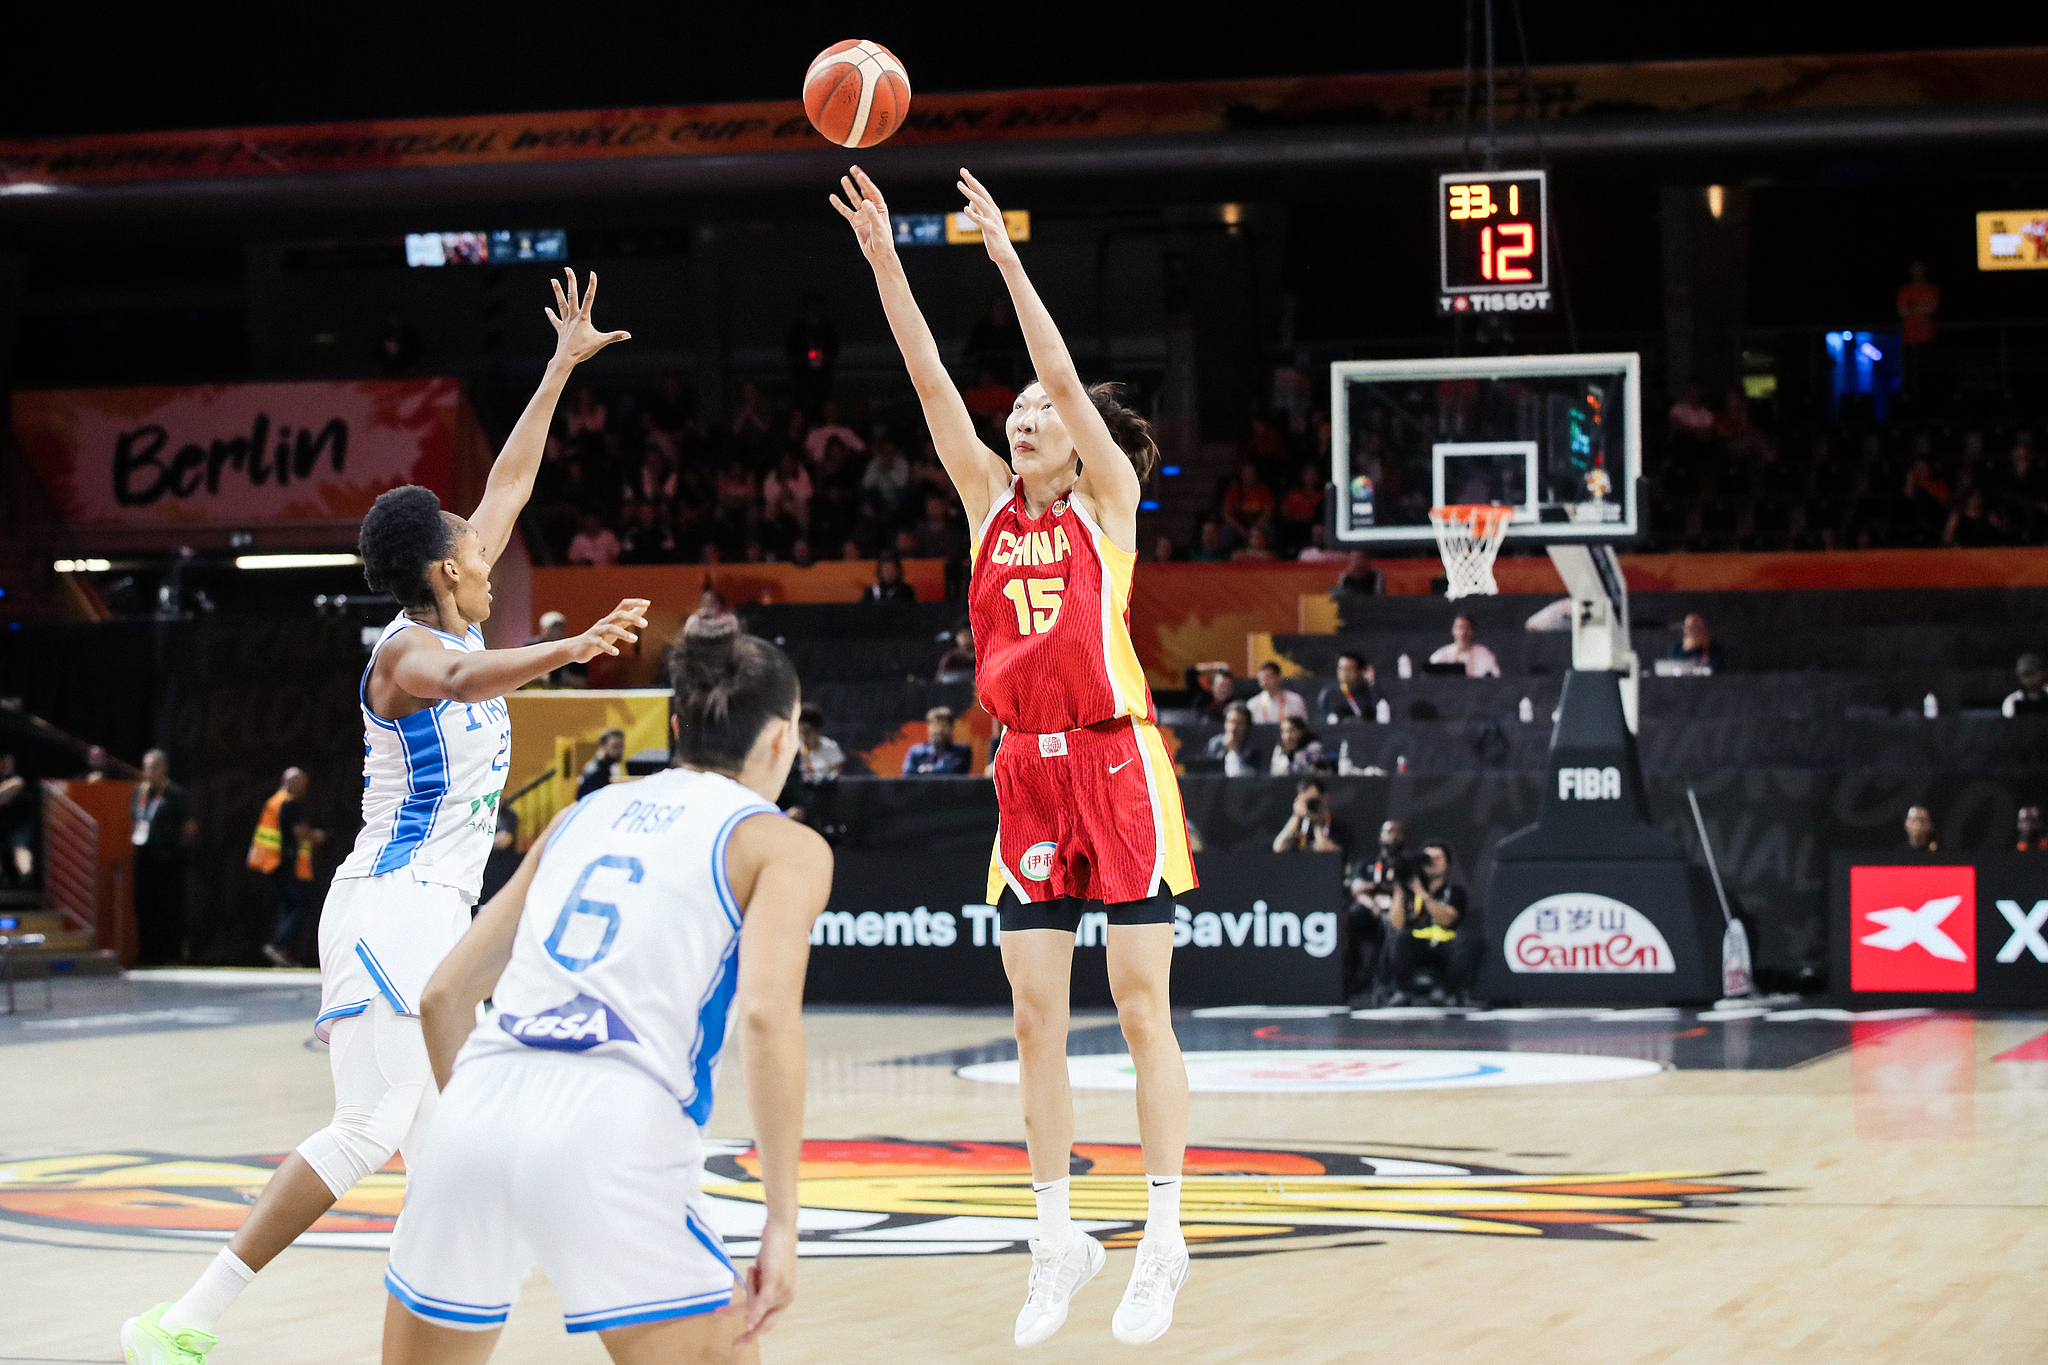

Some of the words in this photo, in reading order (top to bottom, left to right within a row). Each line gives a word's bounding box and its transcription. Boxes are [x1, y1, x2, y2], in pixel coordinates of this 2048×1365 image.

[511, 121, 658, 151] WORLD
[670, 116, 767, 143] CUP
[1449, 184, 1519, 220] 33.1
[1480, 222, 1535, 281] 12
[1469, 292, 1551, 312] TISSOT
[113, 412, 348, 507] Berlin
[992, 525, 1072, 566] CHINA
[1003, 577, 1065, 635] 15
[1558, 766, 1621, 800] FIBA
[611, 800, 687, 833] PASA
[544, 854, 645, 973] 6
[809, 905, 957, 947] ments
[1173, 899, 1337, 958] Saving
[1536, 907, 1626, 932] 百岁山
